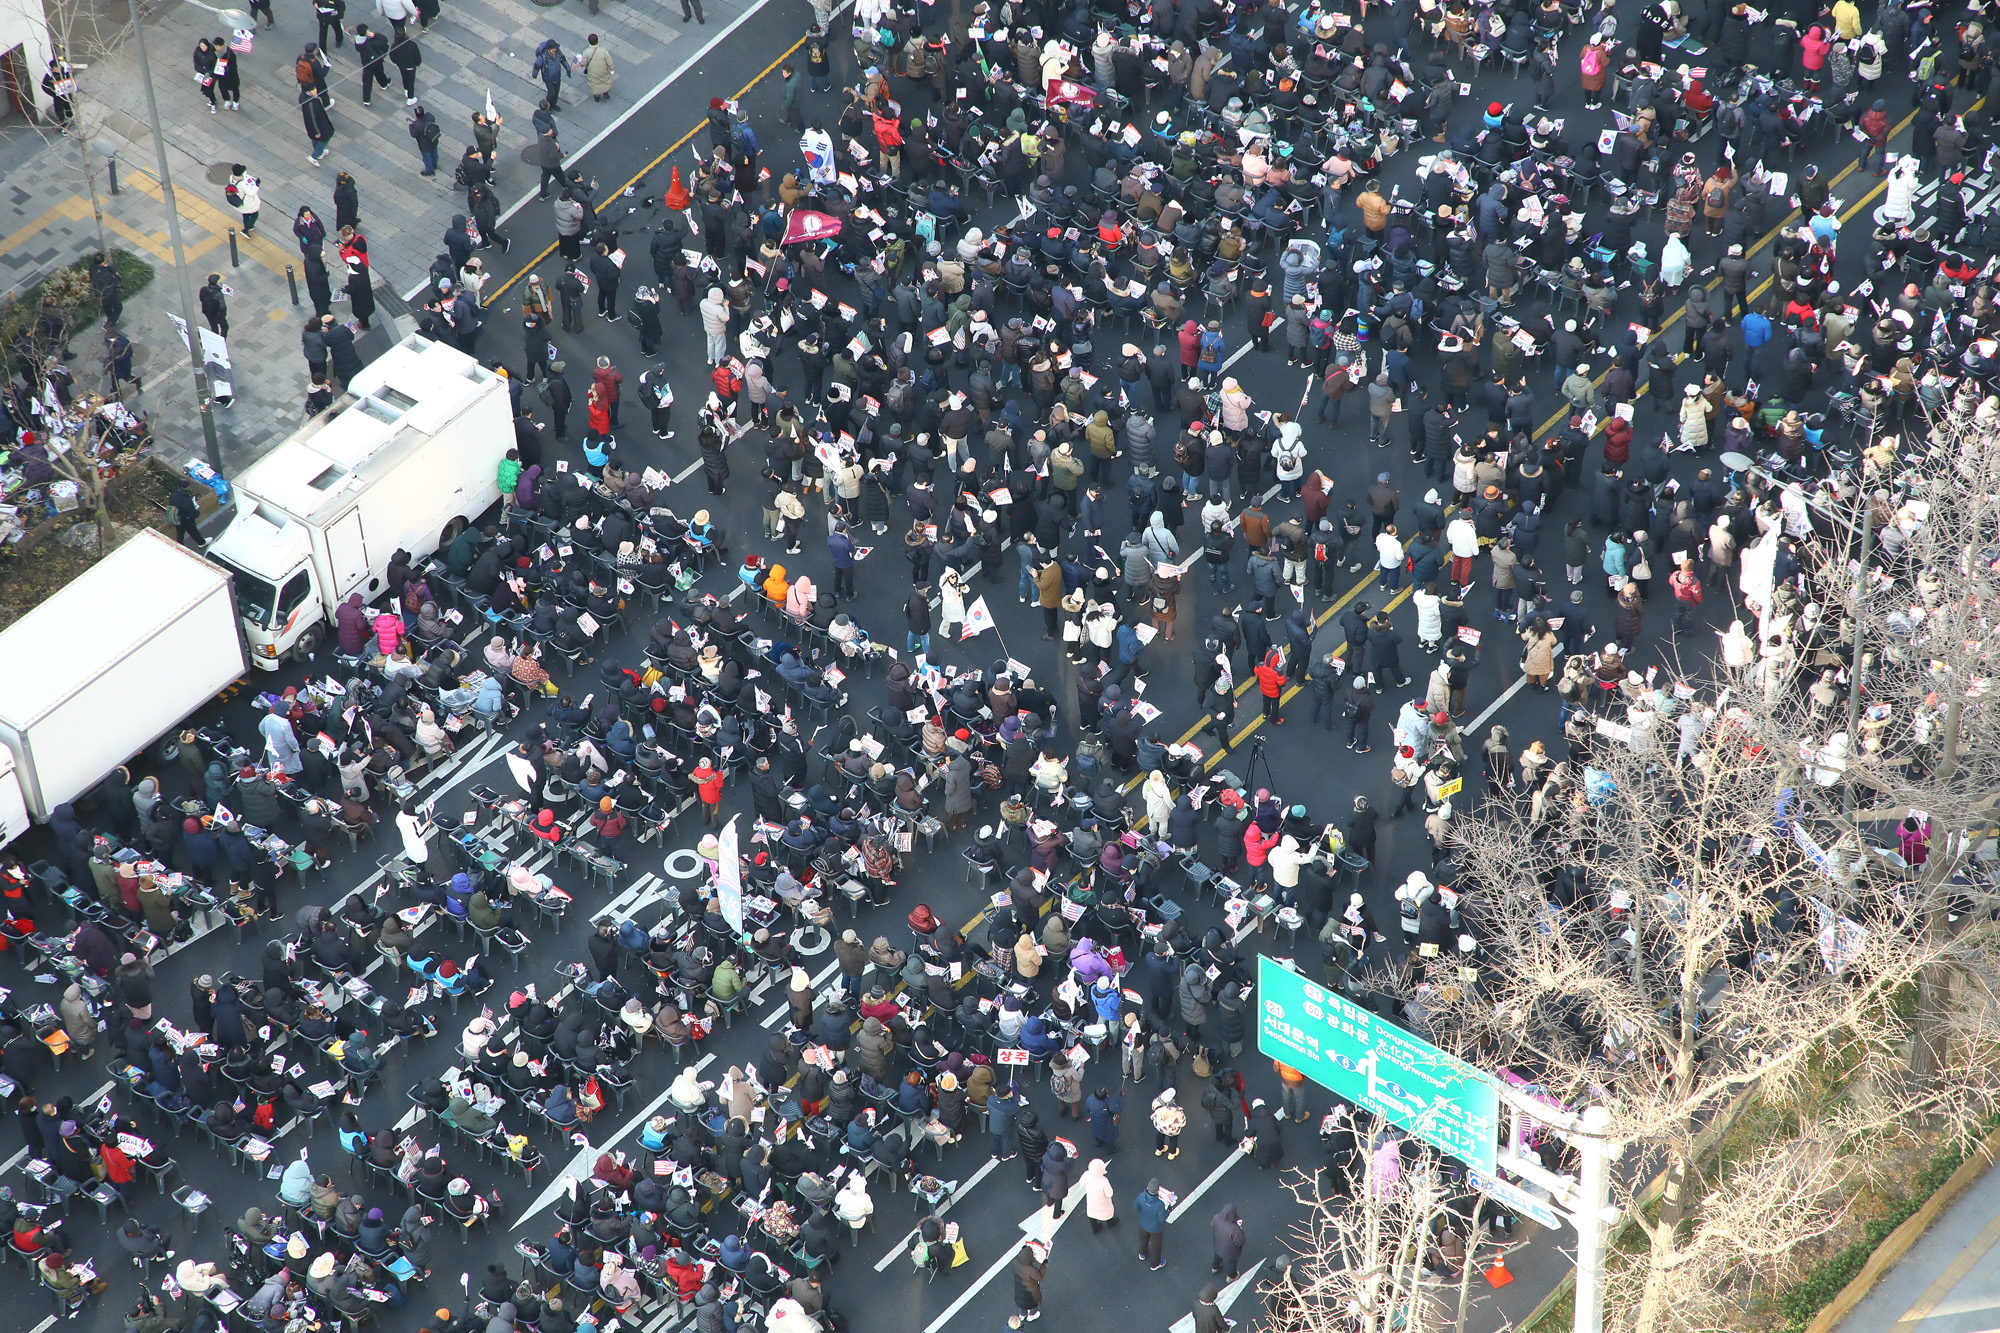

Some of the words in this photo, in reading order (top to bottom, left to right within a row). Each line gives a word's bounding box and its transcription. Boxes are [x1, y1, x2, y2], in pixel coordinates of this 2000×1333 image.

[1326, 1012, 1371, 1046] 광화문
[1327, 995, 1371, 1029] 독립문
[1263, 1014, 1320, 1053] 서대문역
[1263, 1025, 1307, 1055] Seodaemun
[1307, 1048, 1321, 1063] Stn
[999, 1050, 1027, 1063] 상주
[1341, 1058, 1351, 1069] 6
[1392, 1083, 1401, 1096] 6
